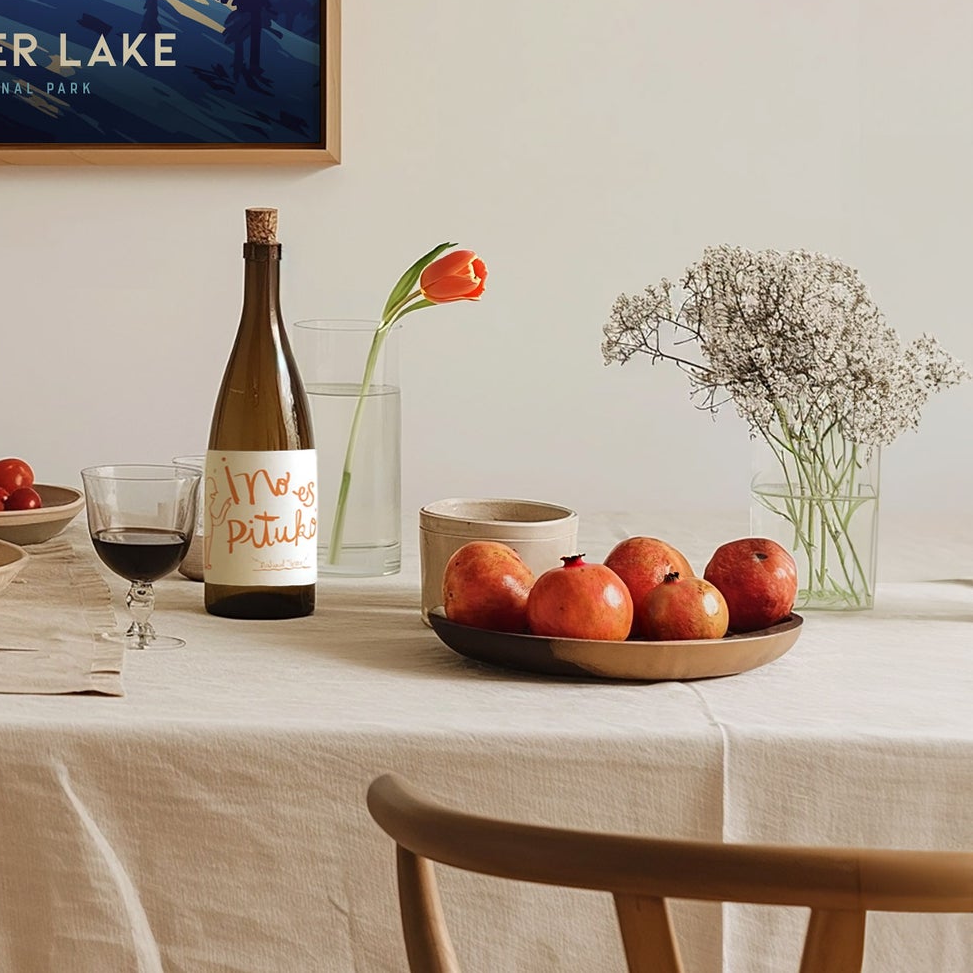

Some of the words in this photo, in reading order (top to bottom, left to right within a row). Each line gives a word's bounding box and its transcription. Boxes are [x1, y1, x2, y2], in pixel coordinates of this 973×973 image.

[60, 32, 177, 67] LAKE
[46, 82, 92, 95] PARK
[292, 481, 315, 507] es
